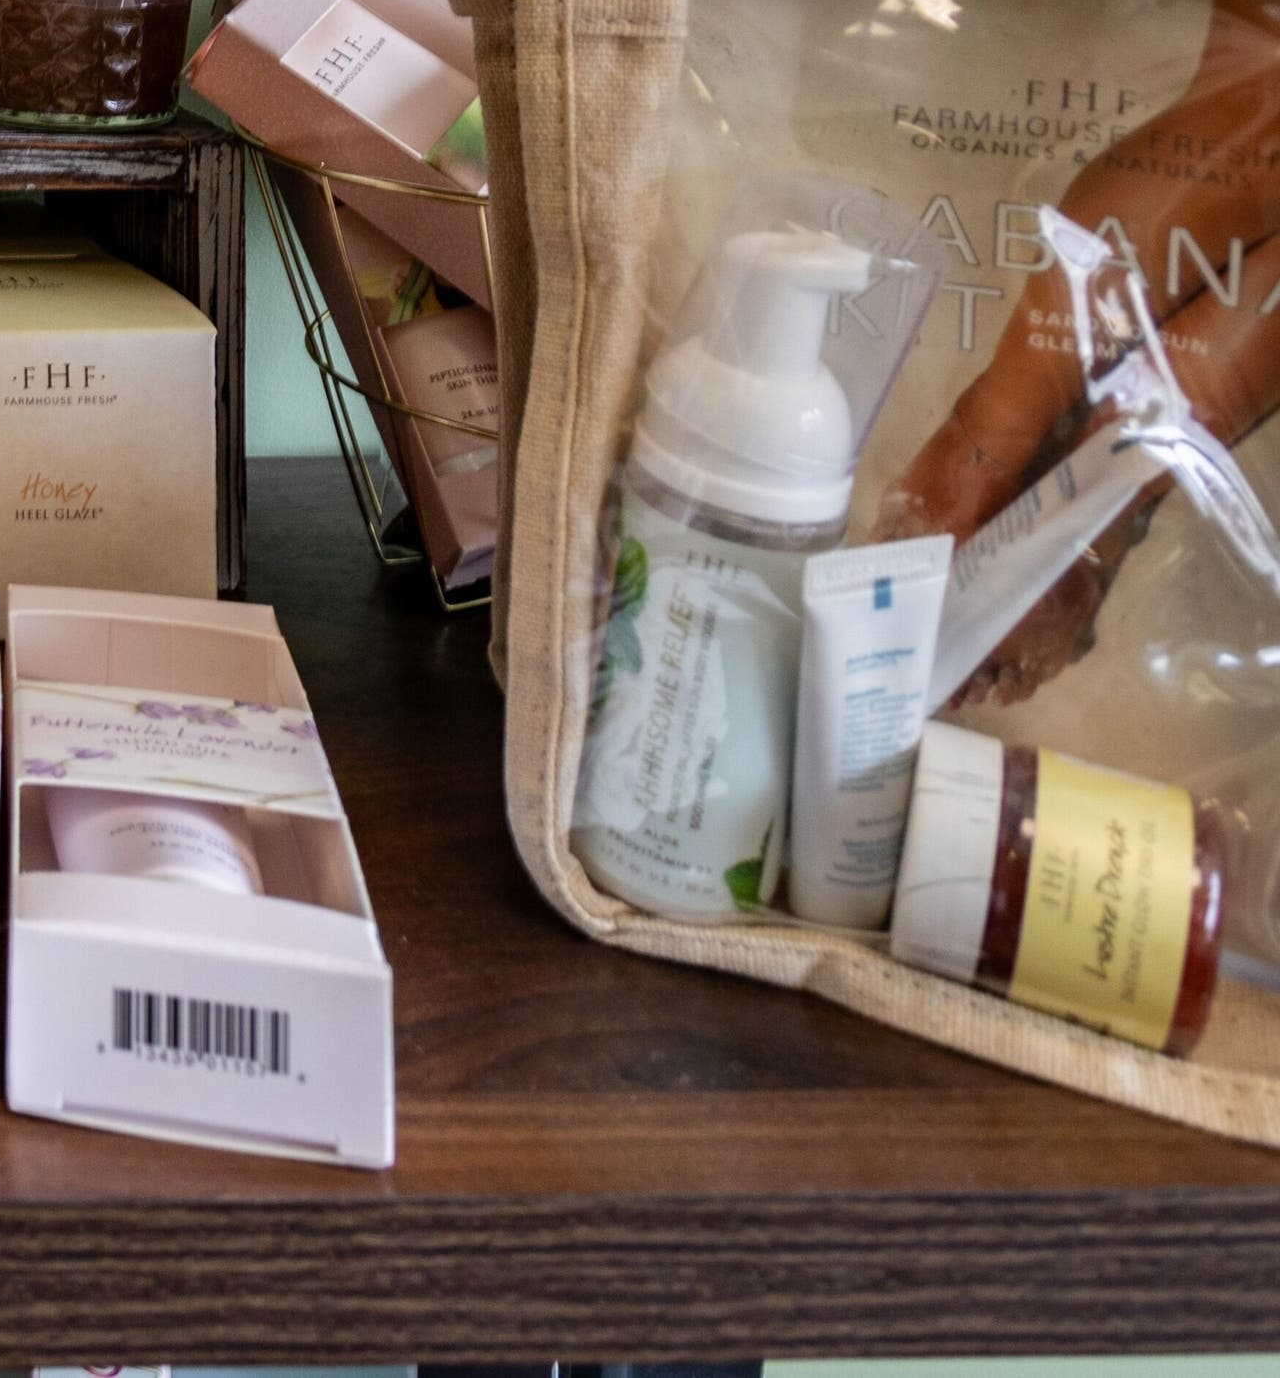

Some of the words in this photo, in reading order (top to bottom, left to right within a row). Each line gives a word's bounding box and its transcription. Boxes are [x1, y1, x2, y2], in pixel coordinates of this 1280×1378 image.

[893, 103, 1124, 146] FARMHOUSE
[911, 133, 1056, 161] ORGANICS
[1103, 154, 1255, 189] NATURALS
[1028, 334, 1119, 359] GLEM
[4, 396, 73, 406] FARMHOUSE
[20, 472, 98, 512] Honey
[15, 508, 52, 521] HEEL
